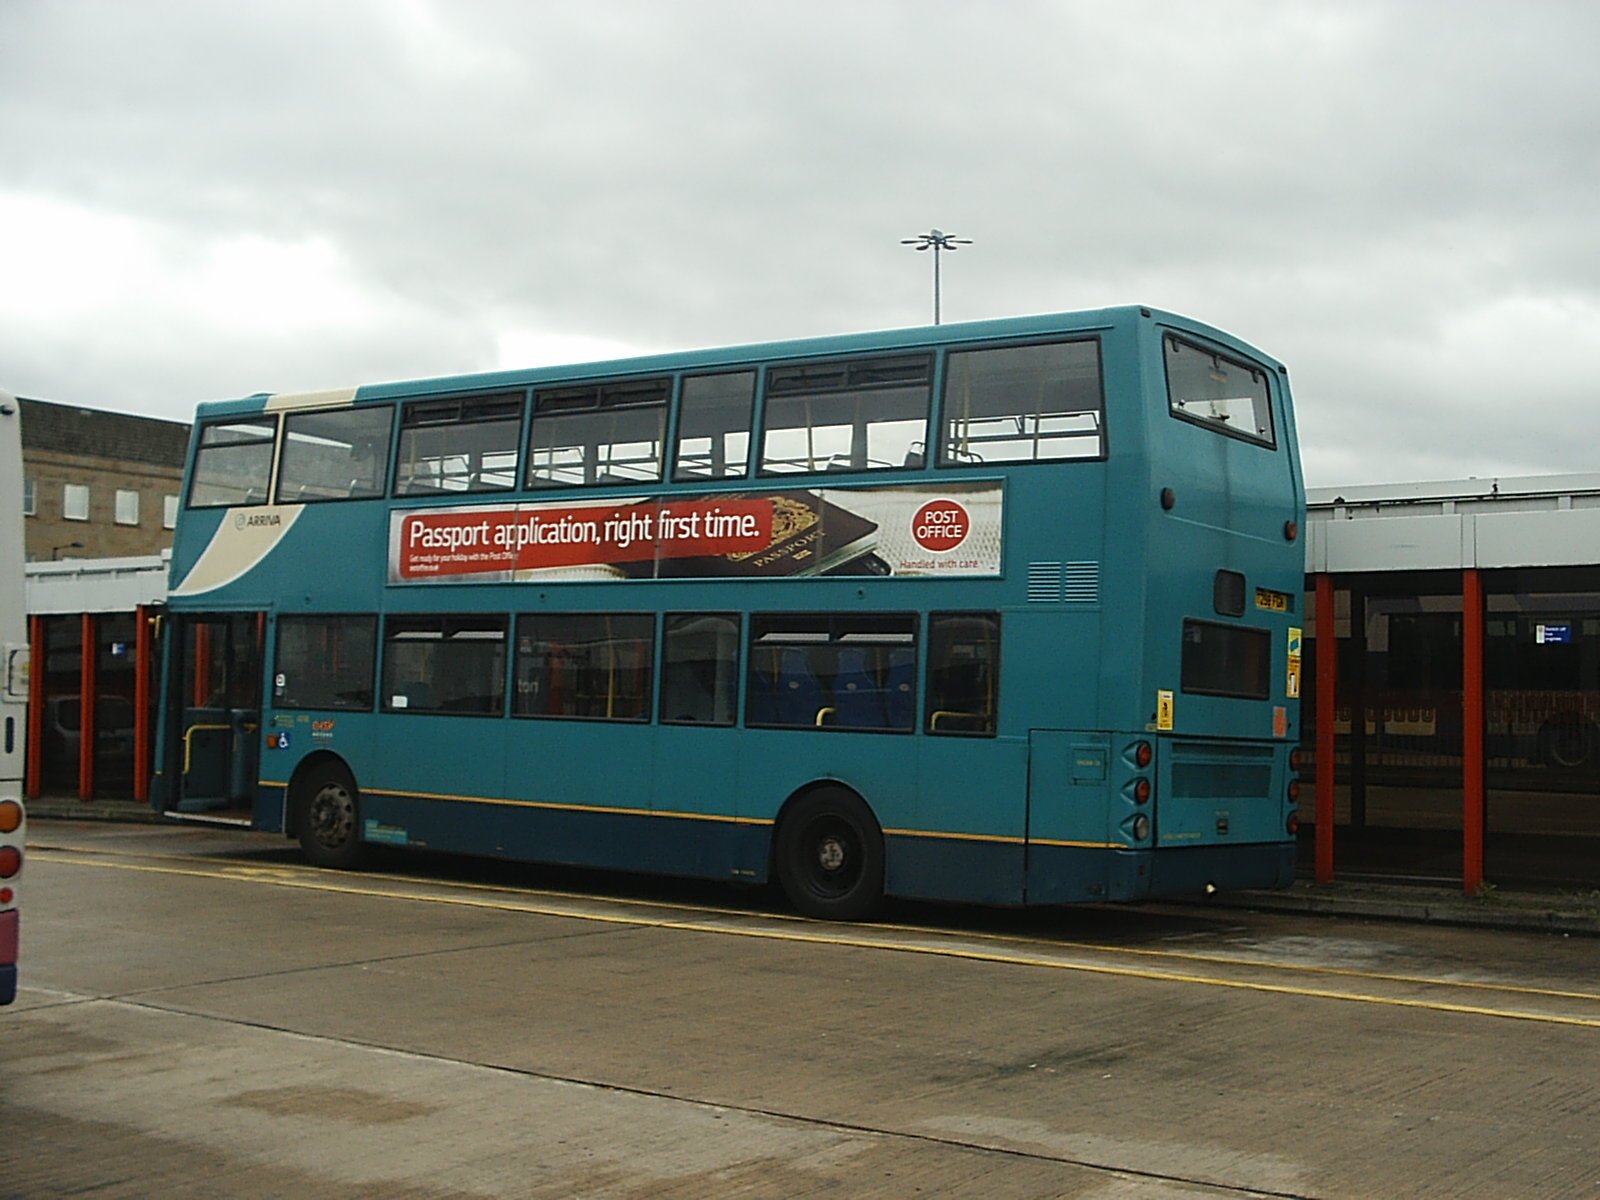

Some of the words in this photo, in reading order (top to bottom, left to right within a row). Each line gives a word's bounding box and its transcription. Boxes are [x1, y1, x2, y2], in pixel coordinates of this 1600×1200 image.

[247, 514, 281, 526] ARRIVA
[924, 510, 959, 524] POST
[409, 519, 490, 552] Passport
[494, 515, 602, 551] application,
[604, 513, 653, 548] right
[658, 510, 700, 540] first
[704, 508, 760, 538] time.
[916, 524, 963, 539] OFFICE
[753, 529, 827, 567] PASSPORT
[489, 552, 501, 560] Post
[900, 560, 935, 569] Handled
[938, 560, 957, 569] with
[959, 560, 979, 569] care
